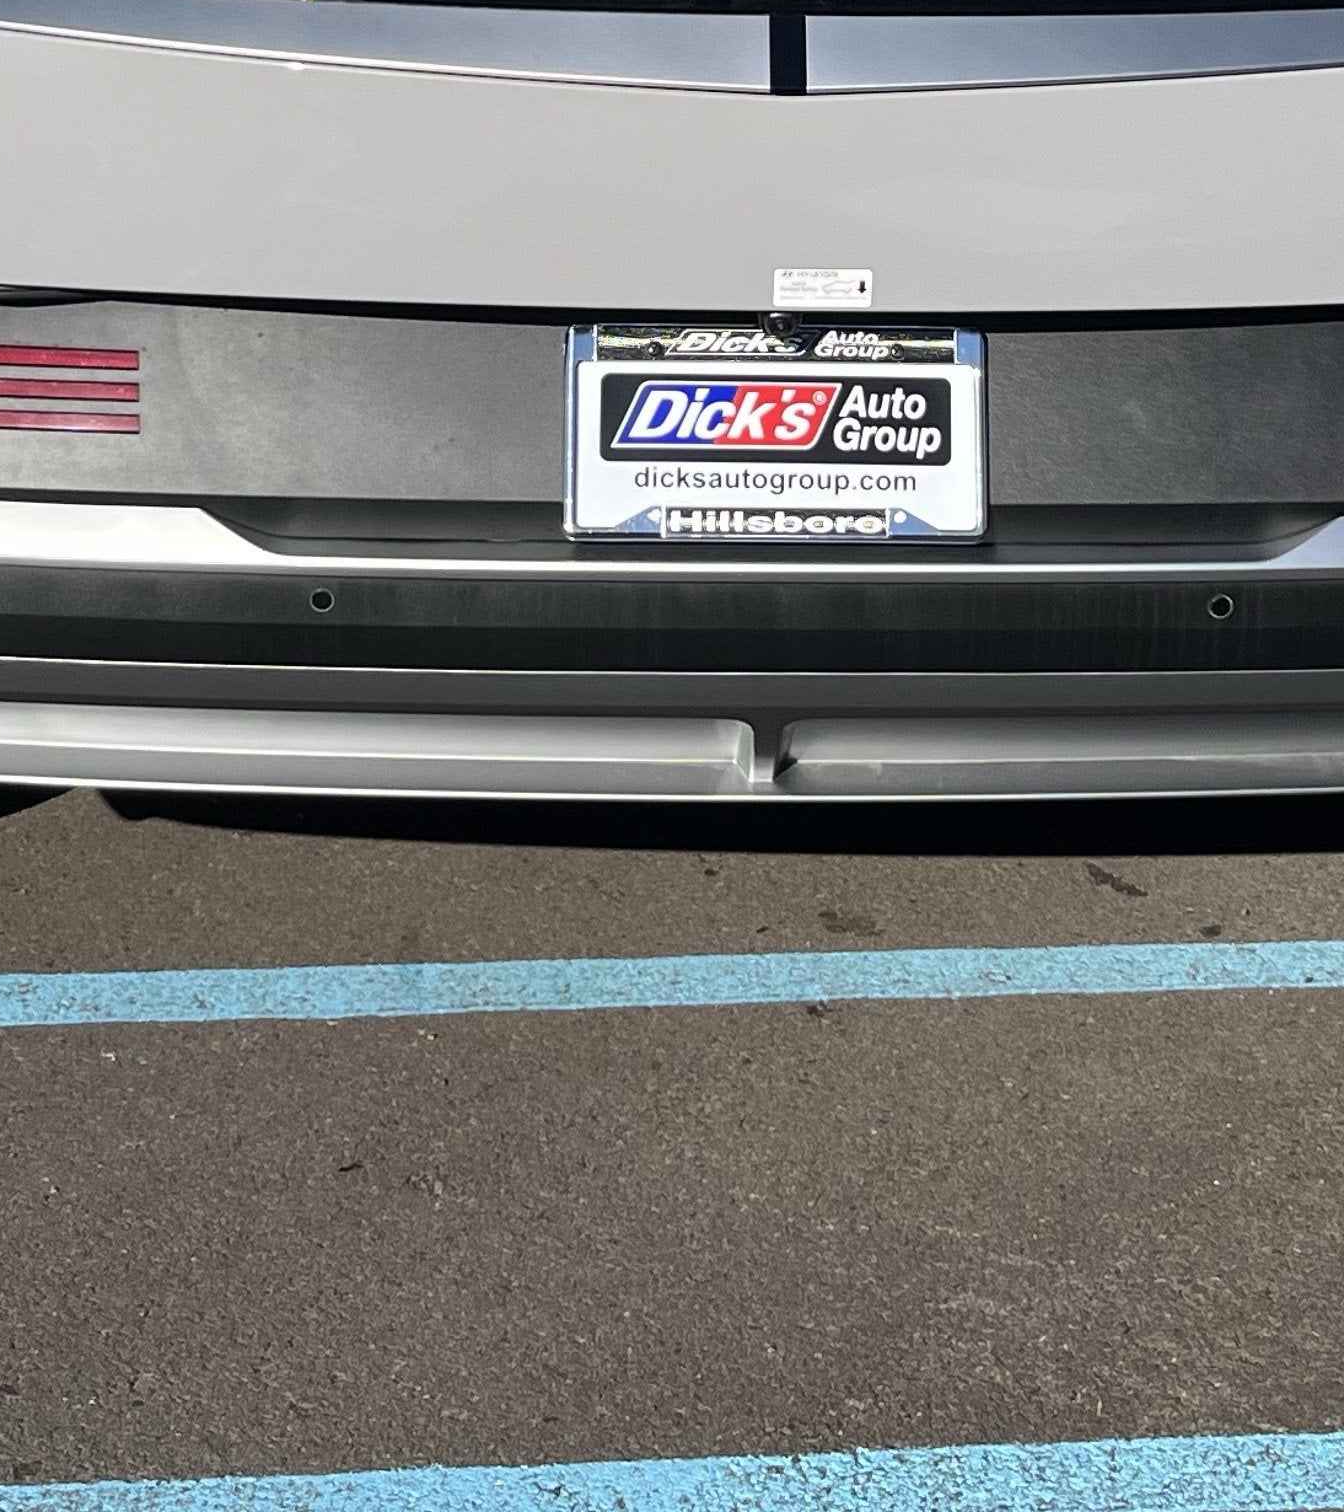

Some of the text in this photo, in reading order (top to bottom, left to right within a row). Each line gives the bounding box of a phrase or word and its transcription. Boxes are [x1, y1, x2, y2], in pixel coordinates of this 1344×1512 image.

[676, 329, 880, 353] Dicks Auto
[814, 342, 891, 359] Group
[628, 385, 926, 440] Dick's Auto
[833, 418, 942, 459] Group
[634, 466, 917, 495] dicksautogroup.com
[668, 509, 884, 534] Hillsboro
